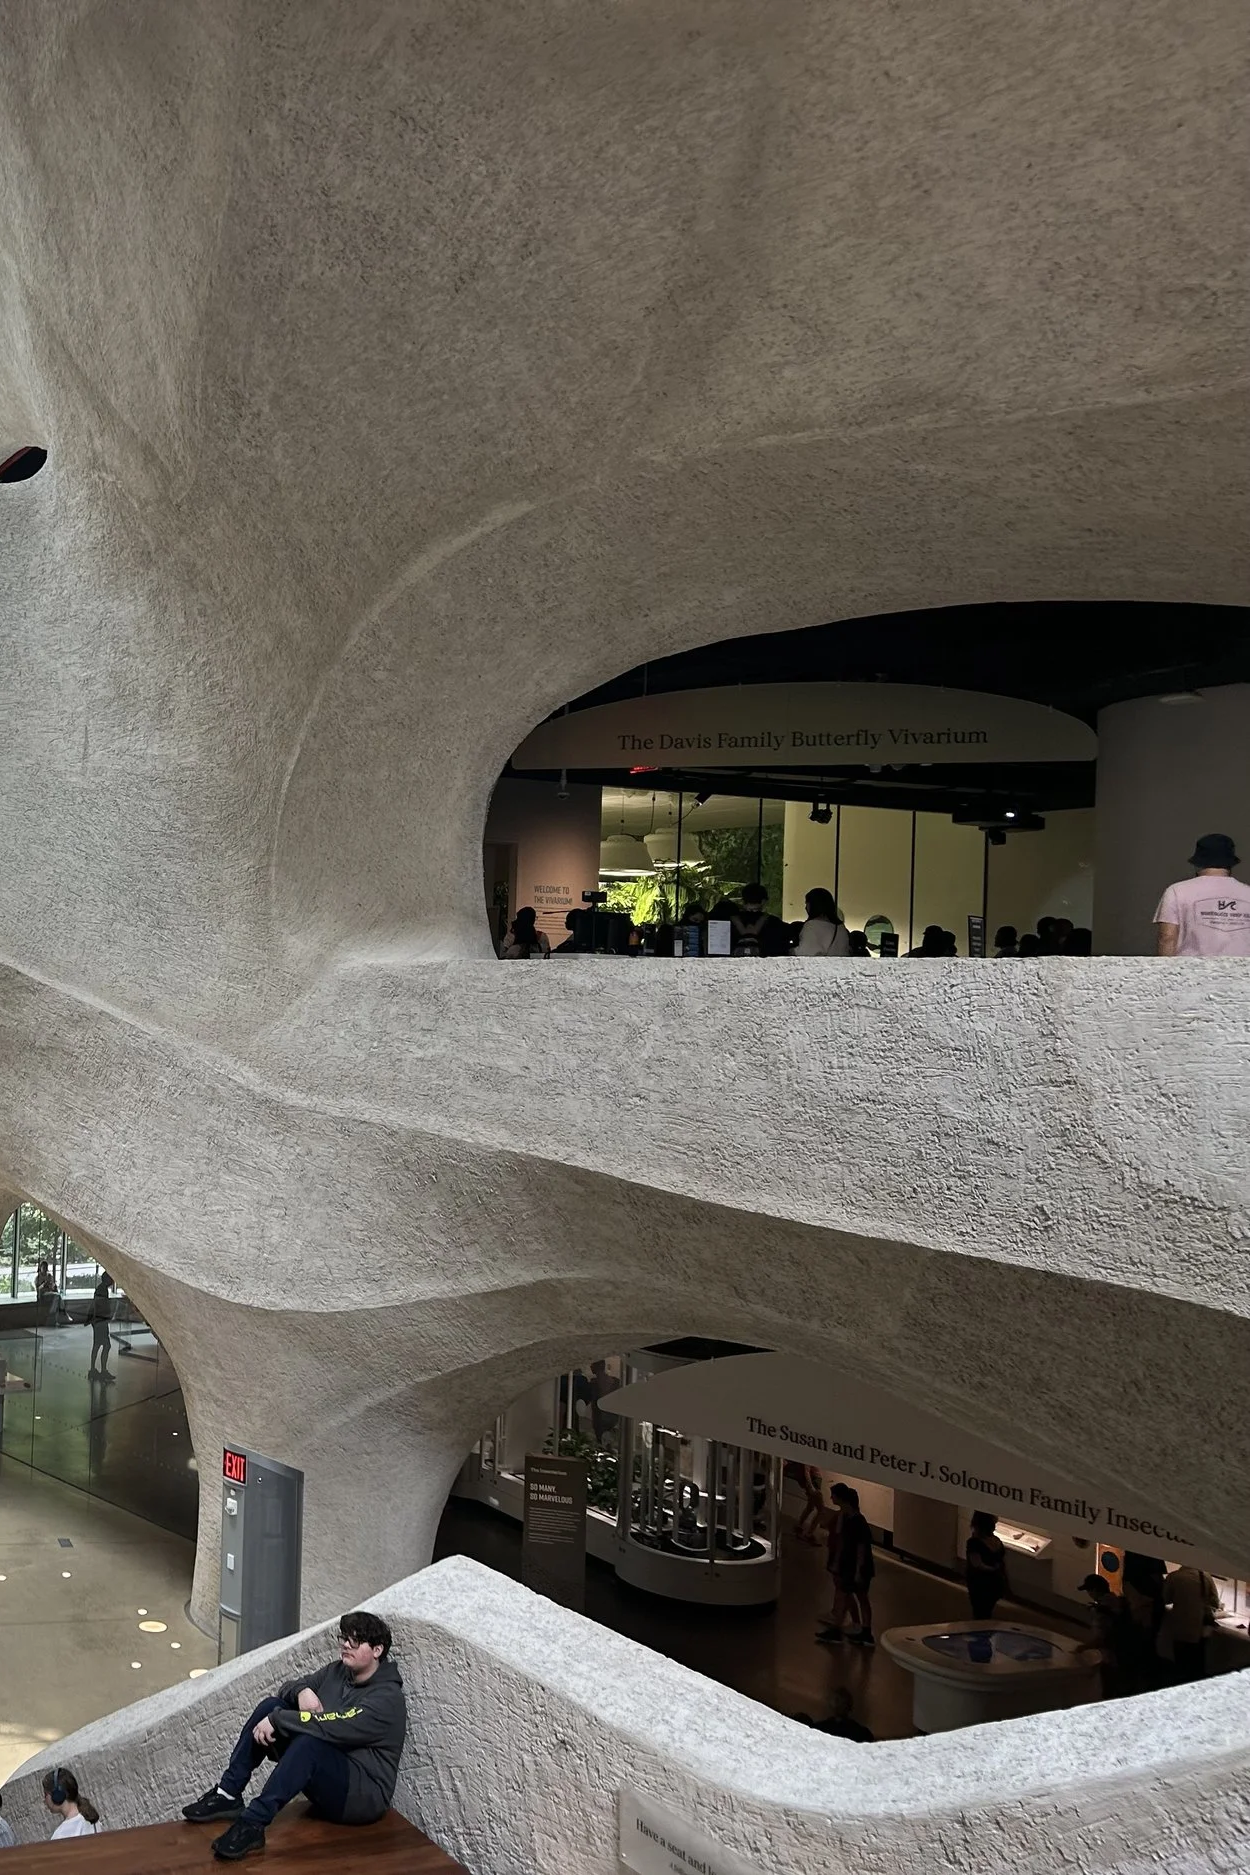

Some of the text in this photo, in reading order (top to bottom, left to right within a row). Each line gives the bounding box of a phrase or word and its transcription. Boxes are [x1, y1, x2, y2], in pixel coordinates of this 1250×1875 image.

[617, 727, 988, 751] The Davis Family Butterfly Vivarium
[534, 886, 561, 894] WELCOME
[534, 896, 544, 904] THE
[225, 1452, 245, 1482] EXIT
[746, 1416, 777, 1438] The
[780, 1425, 828, 1452] Susan
[832, 1441, 865, 1461] and
[869, 1447, 916, 1474] Peter
[919, 1461, 934, 1479] J.
[939, 1465, 1024, 1502] Solomon
[1029, 1487, 1101, 1524] Family
[530, 1482, 538, 1491] SO
[529, 1492, 573, 1505] SO MARVELOUS
[636, 1817, 659, 1843] Have
[660, 1837, 666, 1848] a
[667, 1842, 687, 1862] seat
[687, 1855, 706, 1874] and
